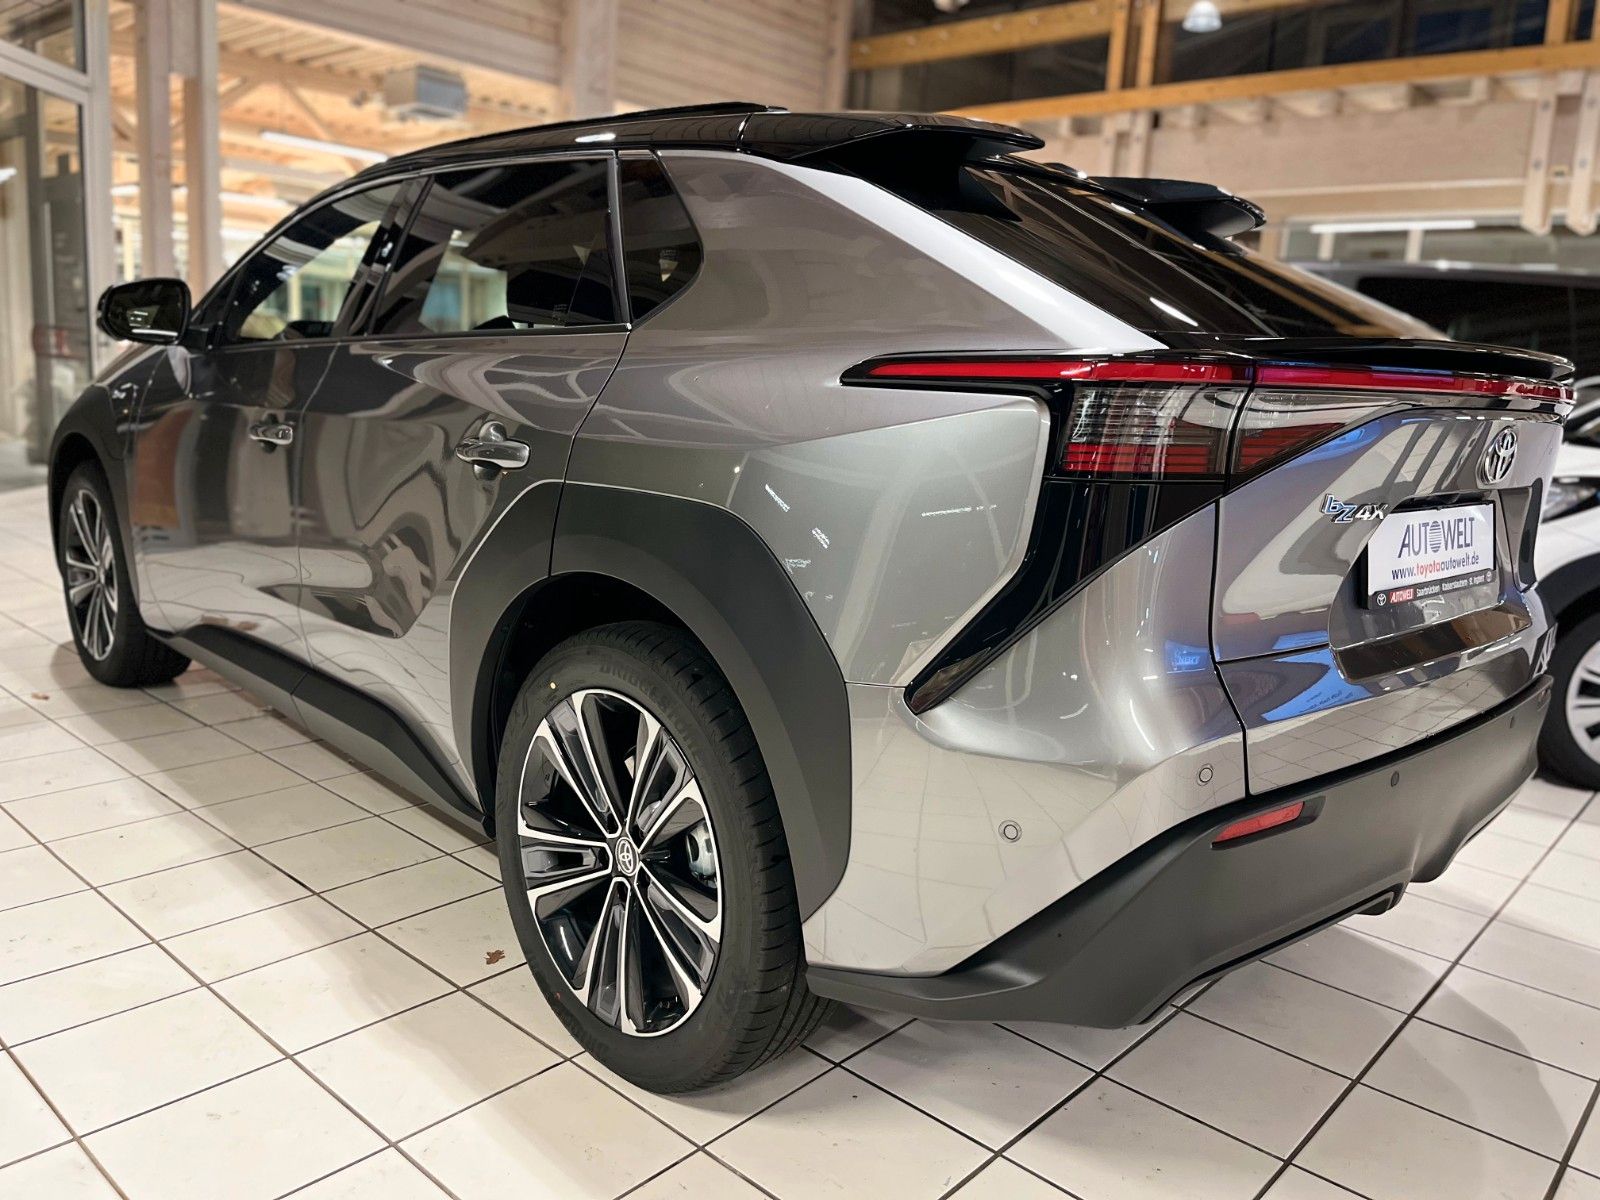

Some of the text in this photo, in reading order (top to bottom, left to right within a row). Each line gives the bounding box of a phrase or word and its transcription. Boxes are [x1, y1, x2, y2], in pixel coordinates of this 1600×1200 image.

[1397, 517, 1475, 559] AUTOWELT
[1391, 551, 1479, 580] www.toyotaautowelt.de
[1390, 588, 1414, 604] AUTOWELT
